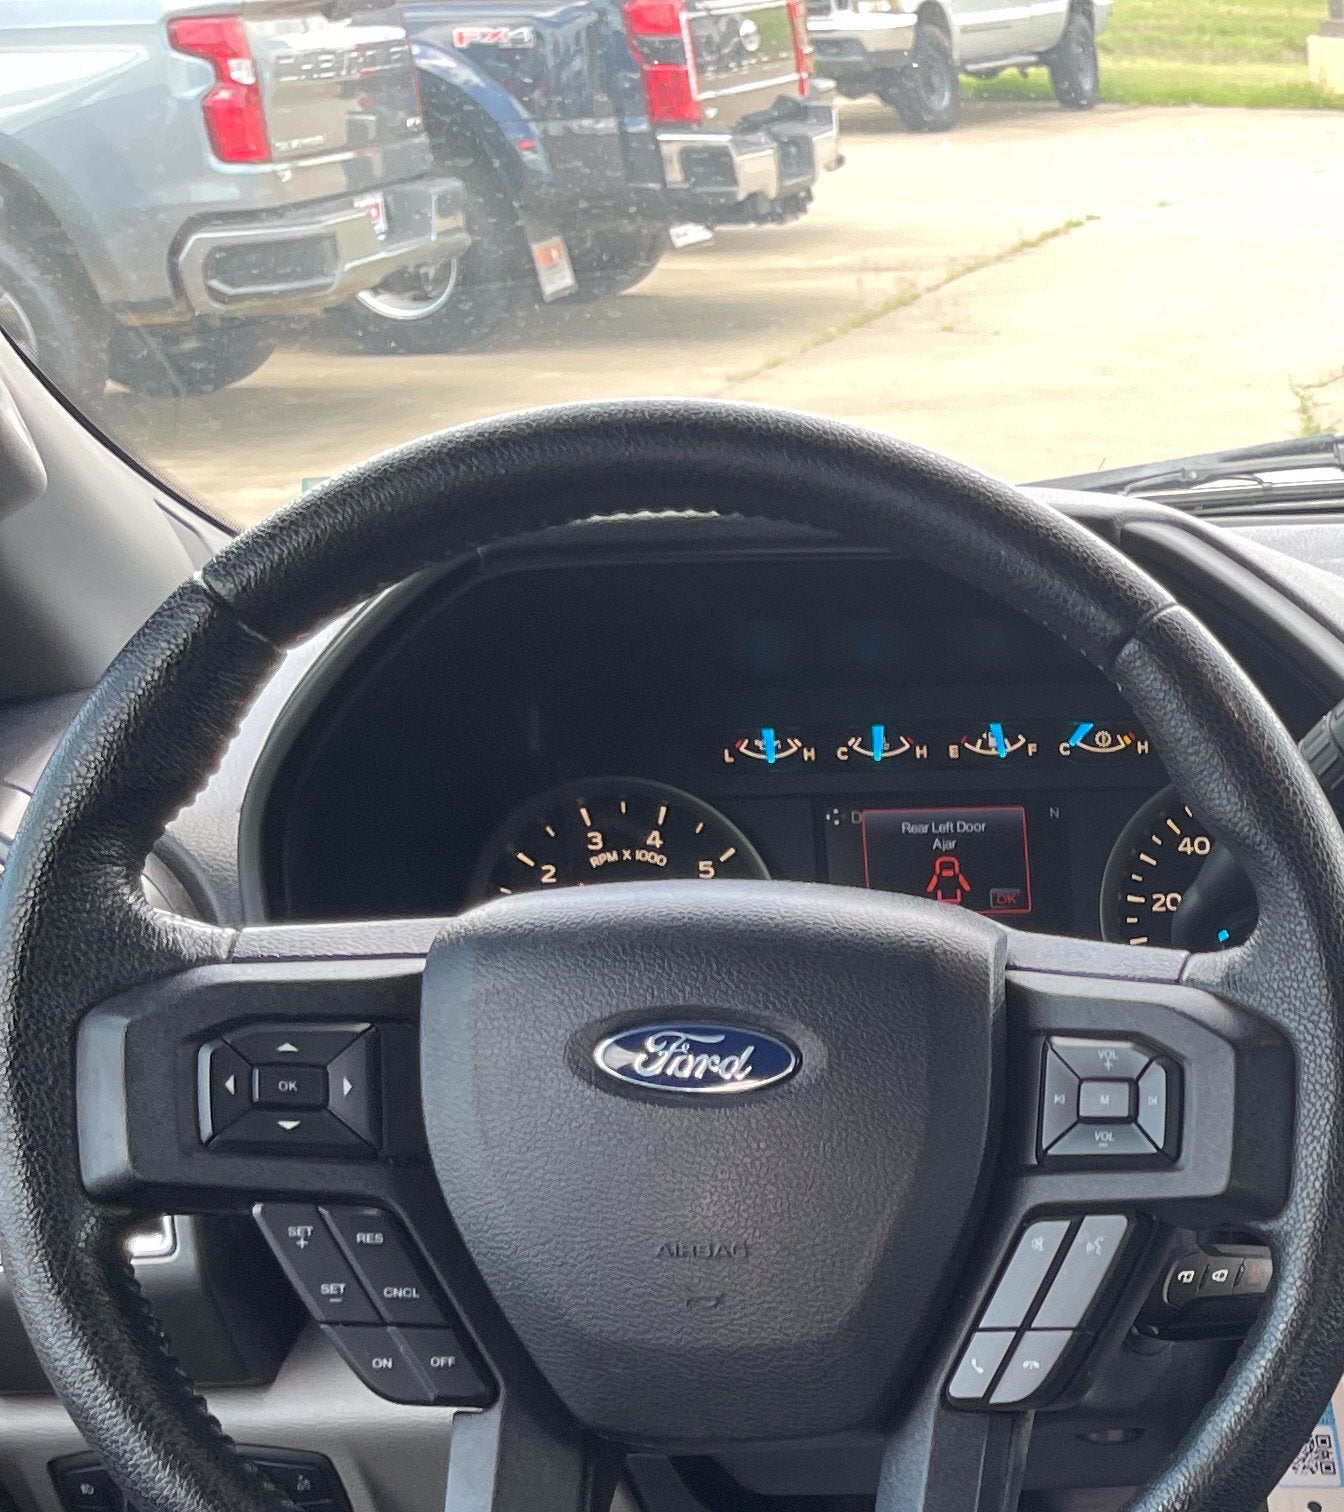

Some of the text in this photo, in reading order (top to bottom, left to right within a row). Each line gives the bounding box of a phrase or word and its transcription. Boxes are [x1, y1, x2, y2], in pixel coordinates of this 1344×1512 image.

[803, 746, 815, 761] H
[837, 747, 849, 761] C
[916, 745, 928, 759] H
[949, 745, 959, 759] E
[1028, 743, 1037, 757] F
[1059, 743, 1070, 757] C
[1137, 741, 1149, 754] H
[724, 750, 735, 763] L
[1050, 808, 1060, 818] N
[901, 820, 986, 834] Rear Left Door
[587, 831, 603, 850] 3
[646, 830, 663, 848] 4
[932, 838, 957, 851] Ajar
[1178, 836, 1211, 855] 40
[589, 850, 618, 868] RPM
[635, 849, 667, 867] 1000
[541, 864, 557, 883] 2
[698, 860, 715, 879] 5
[996, 892, 1016, 905] OK
[1152, 893, 1182, 912] 20
[634, 1031, 755, 1080] Ford
[1098, 1050, 1118, 1059] VOL
[278, 1080, 298, 1092] OK
[1100, 1096, 1110, 1105] M
[1095, 1131, 1114, 1141] VOL
[288, 1226, 314, 1238] SET
[356, 1232, 384, 1244] RES
[320, 1283, 346, 1294] SET
[383, 1287, 420, 1299] CNCL
[372, 1357, 393, 1368] ON
[430, 1356, 456, 1367] OFF
